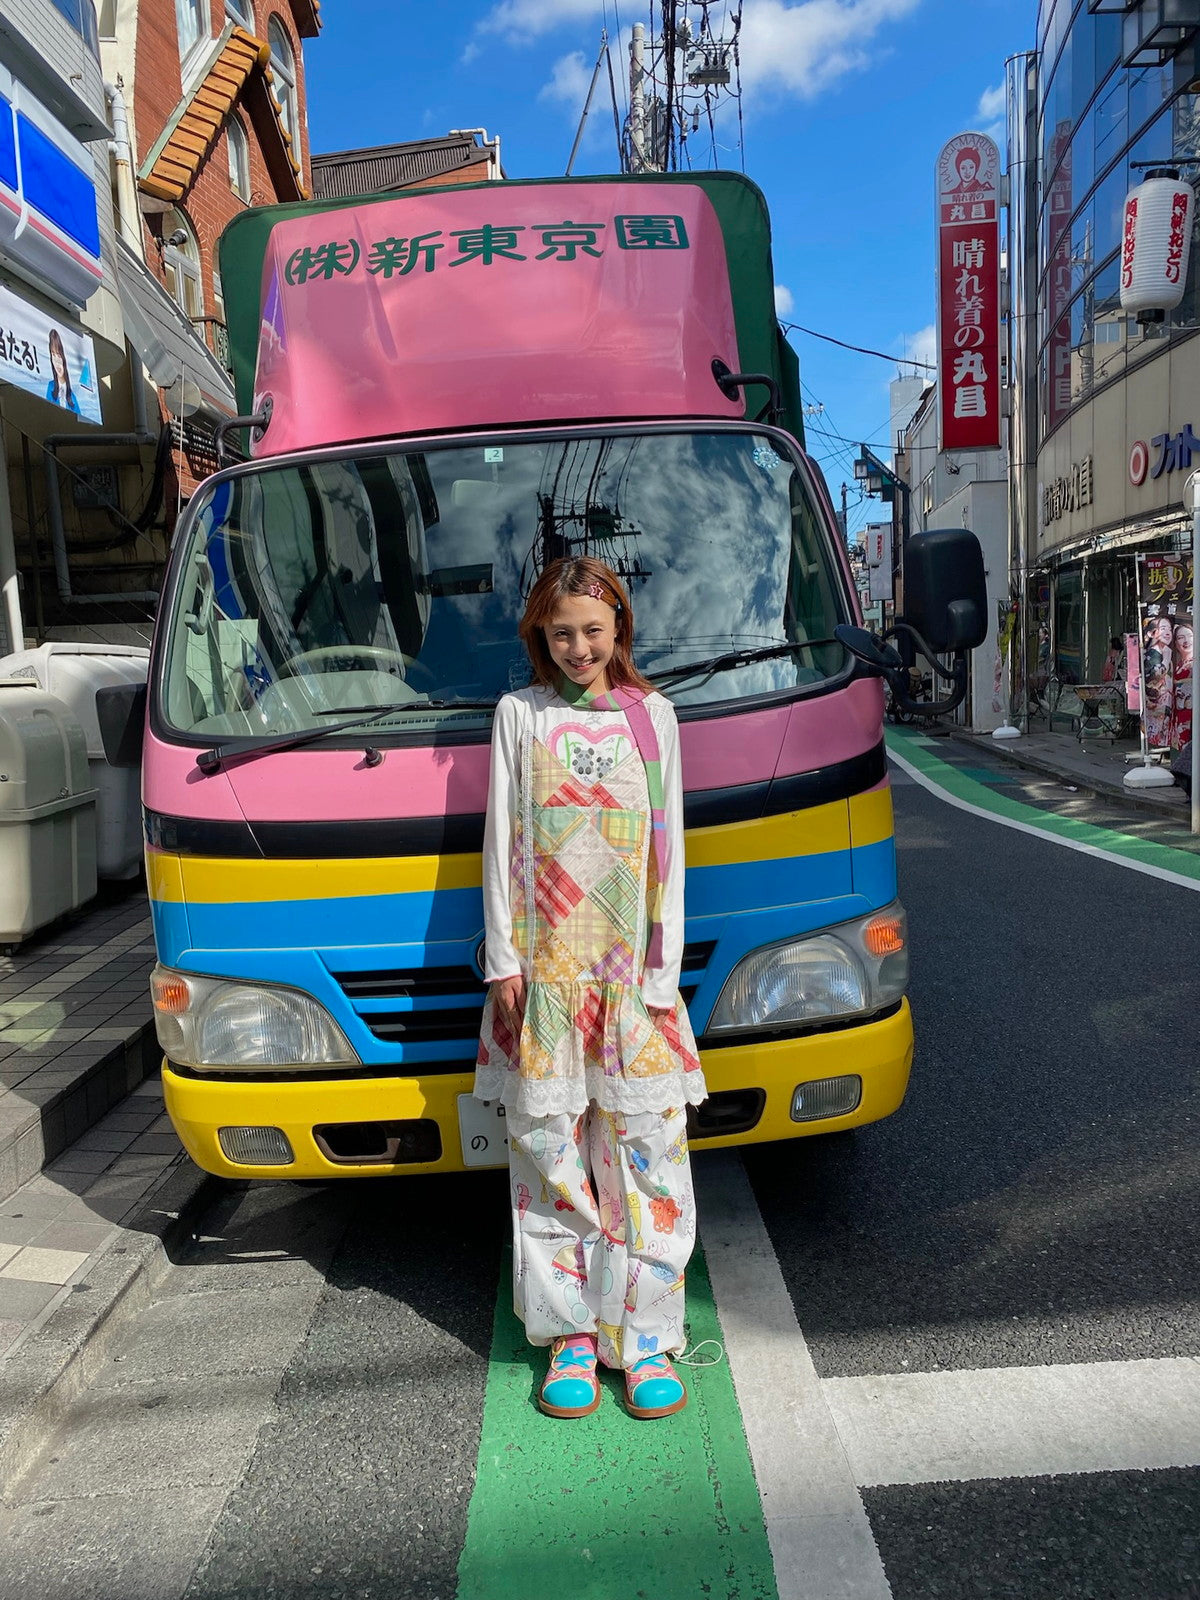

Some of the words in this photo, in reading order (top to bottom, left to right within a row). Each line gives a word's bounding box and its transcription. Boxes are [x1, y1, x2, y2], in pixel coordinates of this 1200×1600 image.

[950, 203, 986, 221] 丸昌
[952, 237, 988, 419] 晴れ着の丸昌
[471, 1135, 489, 1152] の
